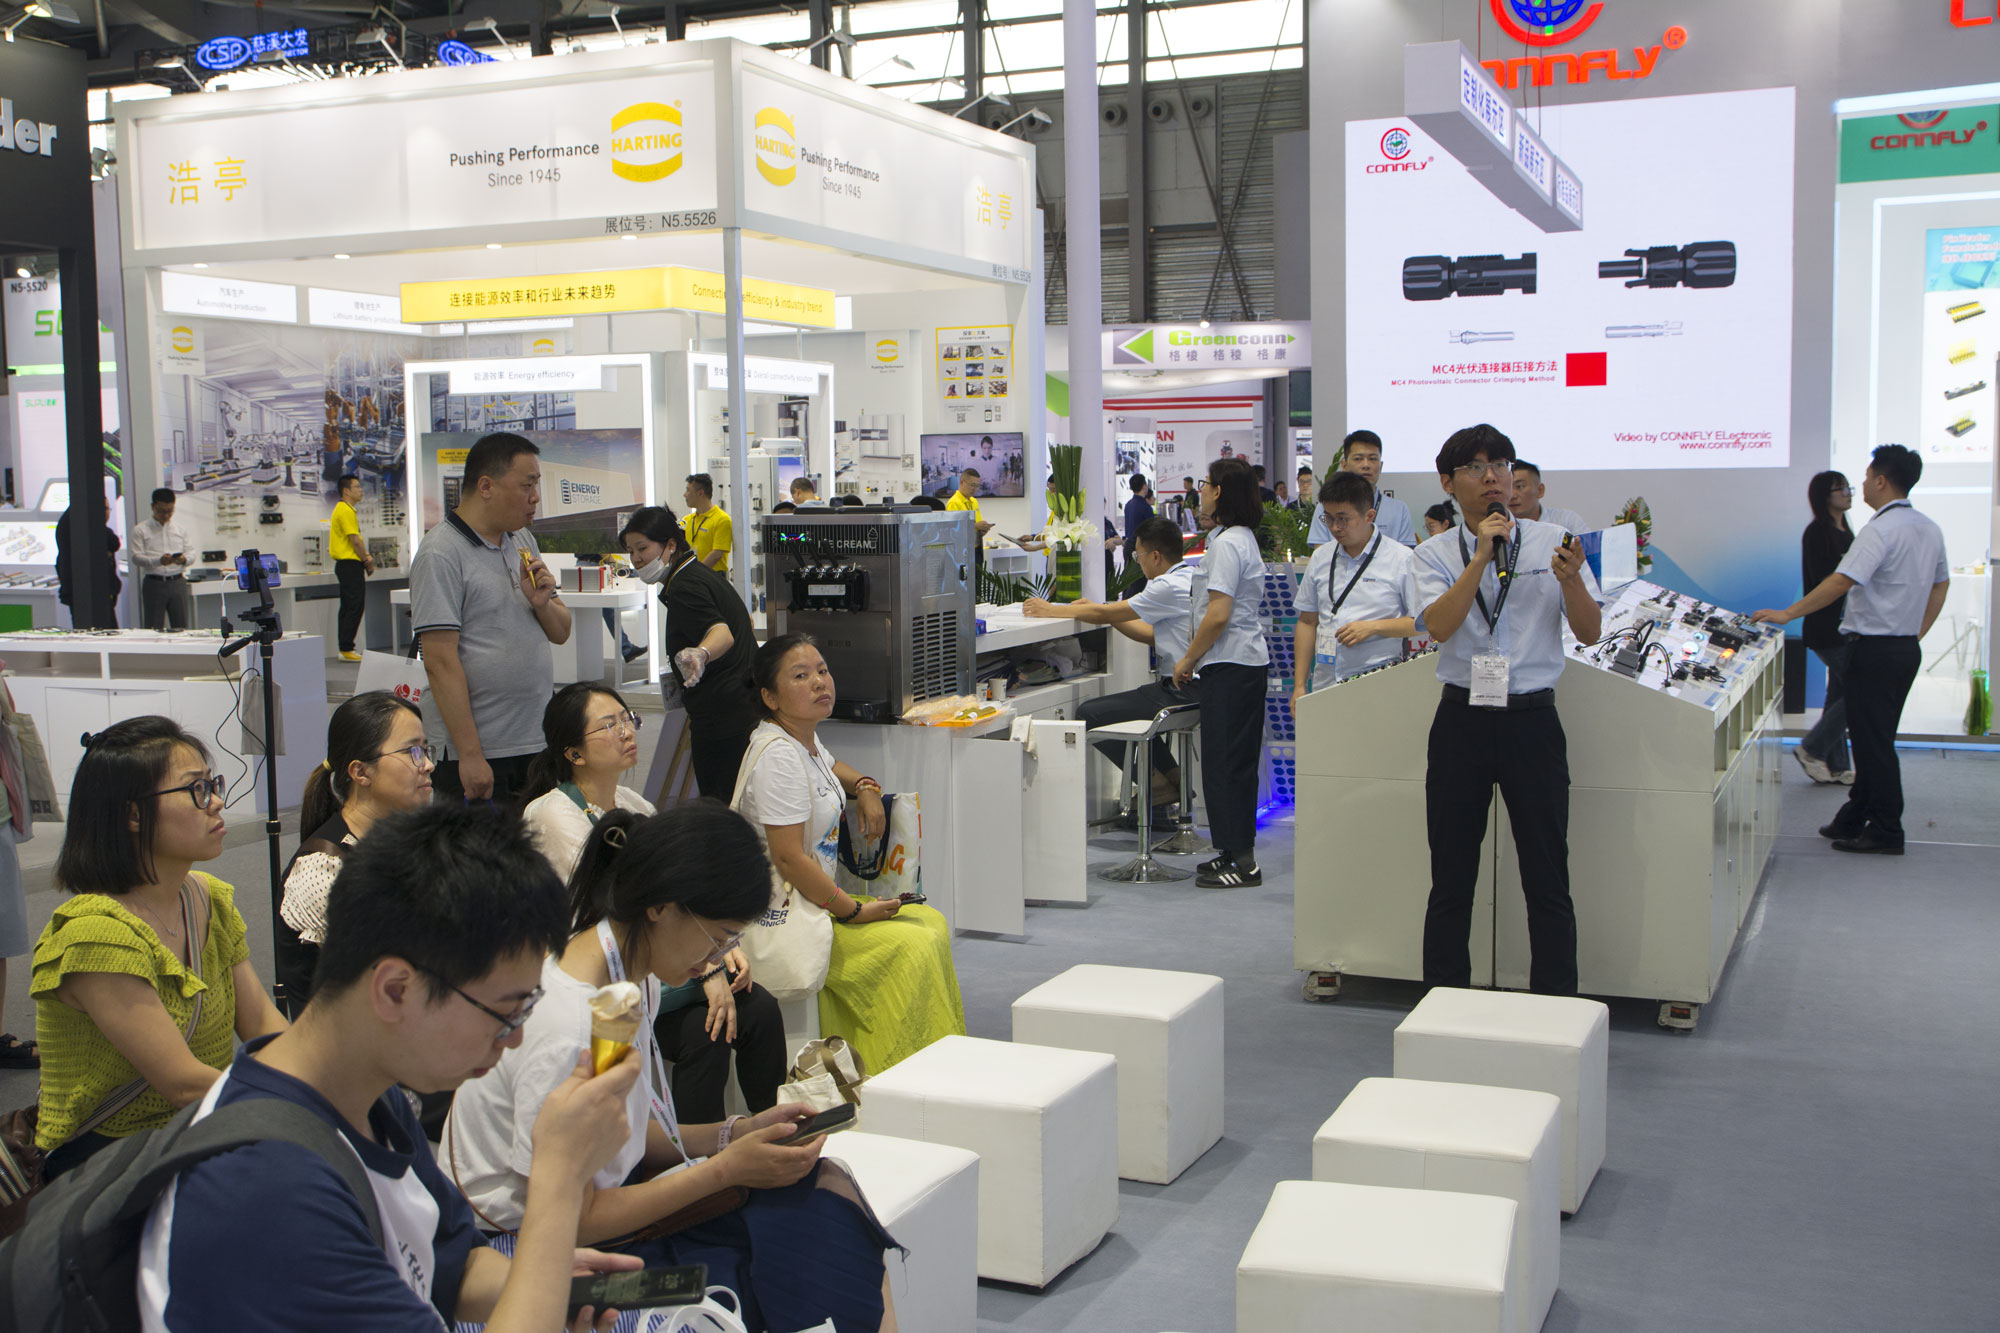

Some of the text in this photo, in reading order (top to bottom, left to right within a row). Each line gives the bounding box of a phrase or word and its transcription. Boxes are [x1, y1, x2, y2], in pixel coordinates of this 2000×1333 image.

[205, 43, 243, 63] CSP
[1480, 45, 1663, 89] ONNFLY
[611, 132, 682, 153] HARTING
[755, 135, 795, 159] HARTING
[1870, 129, 1976, 150] CONNFLY
[450, 143, 600, 166] Pushing Performance
[801, 147, 880, 182] Pushing Performance
[169, 157, 247, 204] 浩亭
[488, 168, 561, 187] Since 1945
[822, 176, 862, 199] Since 1945
[976, 185, 1012, 230] 浩亭
[661, 211, 717, 228] N5.5526
[450, 284, 616, 307] 连接能源效率和行业未来趋势
[692, 283, 727, 300] Connecti
[775, 296, 780, 307] &
[781, 298, 806, 313] industry
[807, 302, 823, 313] trend
[233, 303, 268, 313] production
[1168, 330, 1287, 346] Greenconn
[474, 368, 576, 381] 能源效率 Energy efficiency
[1408, 377, 1452, 385] Photovoltaic
[1454, 376, 1491, 384] Connector
[1493, 375, 1526, 384] Crimping
[1528, 374, 1556, 382] Method
[1614, 431, 1643, 442] Video
[1645, 431, 1657, 443] by
[1660, 430, 1713, 441] CONNFLY
[571, 482, 600, 494] ENERGY
[571, 494, 602, 504] STORAGE
[836, 539, 872, 549] CREAM
